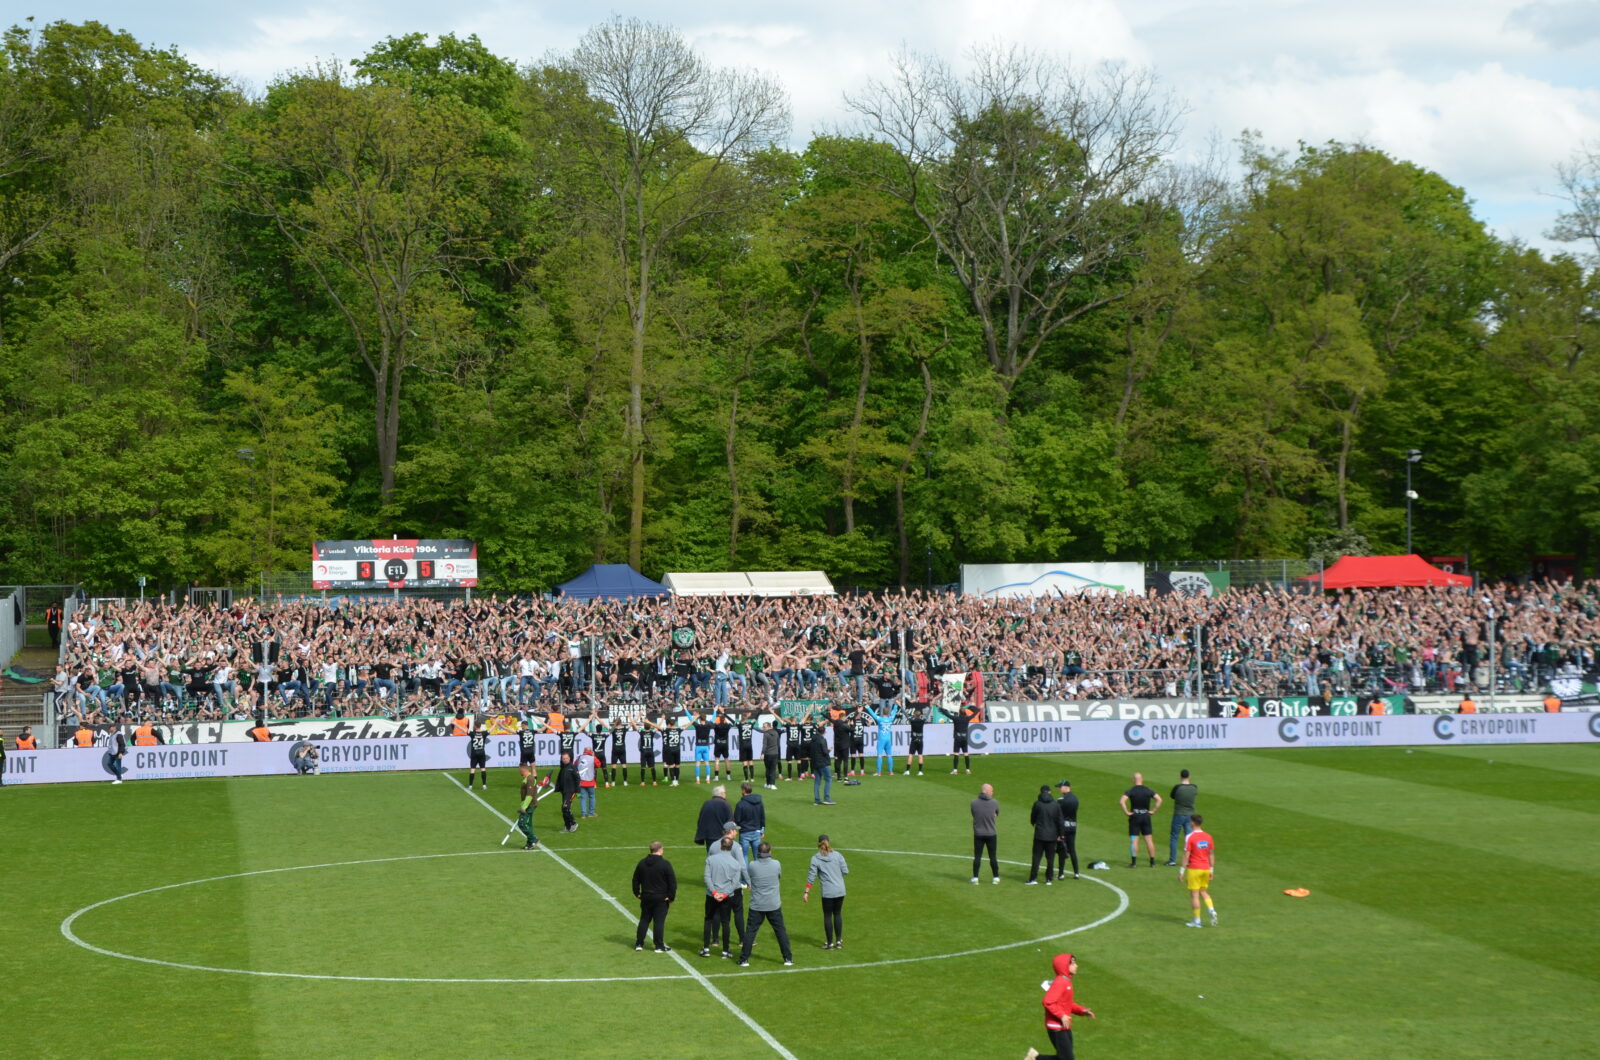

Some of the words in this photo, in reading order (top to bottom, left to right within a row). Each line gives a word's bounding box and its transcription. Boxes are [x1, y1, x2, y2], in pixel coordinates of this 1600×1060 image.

[353, 545, 391, 554] Viktoria
[416, 545, 437, 553] 1904
[361, 562, 371, 578] 3
[421, 561, 431, 577] 5
[790, 729, 798, 738] 18
[805, 728, 811, 738] 5
[1152, 724, 1228, 740] CRYOPOINT
[1306, 721, 1382, 737] CRYOPOINT
[1461, 718, 1537, 735] CRYOPOINT
[522, 735, 533, 745] 32
[562, 737, 573, 746] 27
[669, 734, 679, 744] 28
[994, 727, 1071, 744] CRYOPOINT
[321, 744, 409, 762] CRYOPOINT
[596, 740, 602, 750] 7
[136, 749, 228, 769] CRYOPOINT
